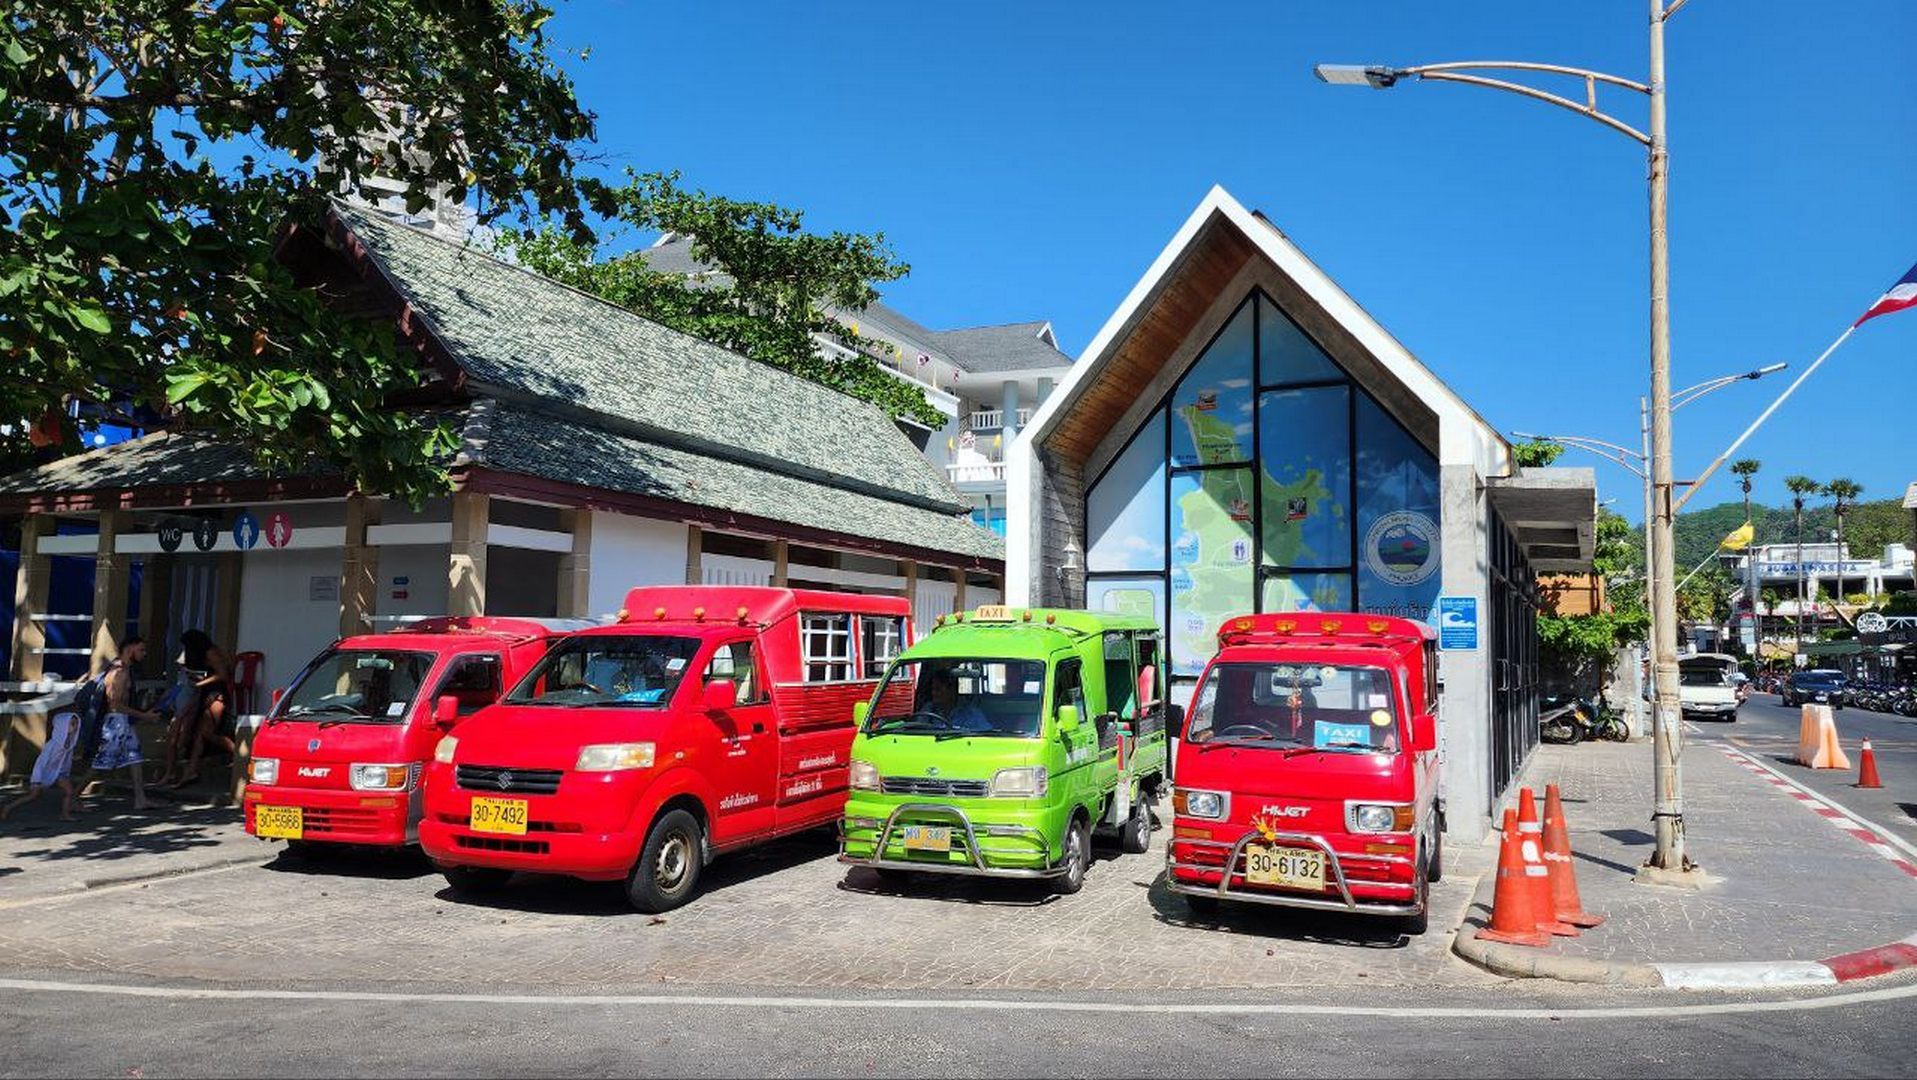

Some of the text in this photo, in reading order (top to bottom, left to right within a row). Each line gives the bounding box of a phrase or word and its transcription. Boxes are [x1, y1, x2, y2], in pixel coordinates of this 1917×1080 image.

[161, 528, 180, 541] WC
[980, 607, 1004, 618] TAXI
[1320, 726, 1363, 737] TAXI
[473, 804, 525, 825] 30-7492
[1261, 804, 1311, 817] HIJET
[1251, 853, 1320, 879] 30-6132
